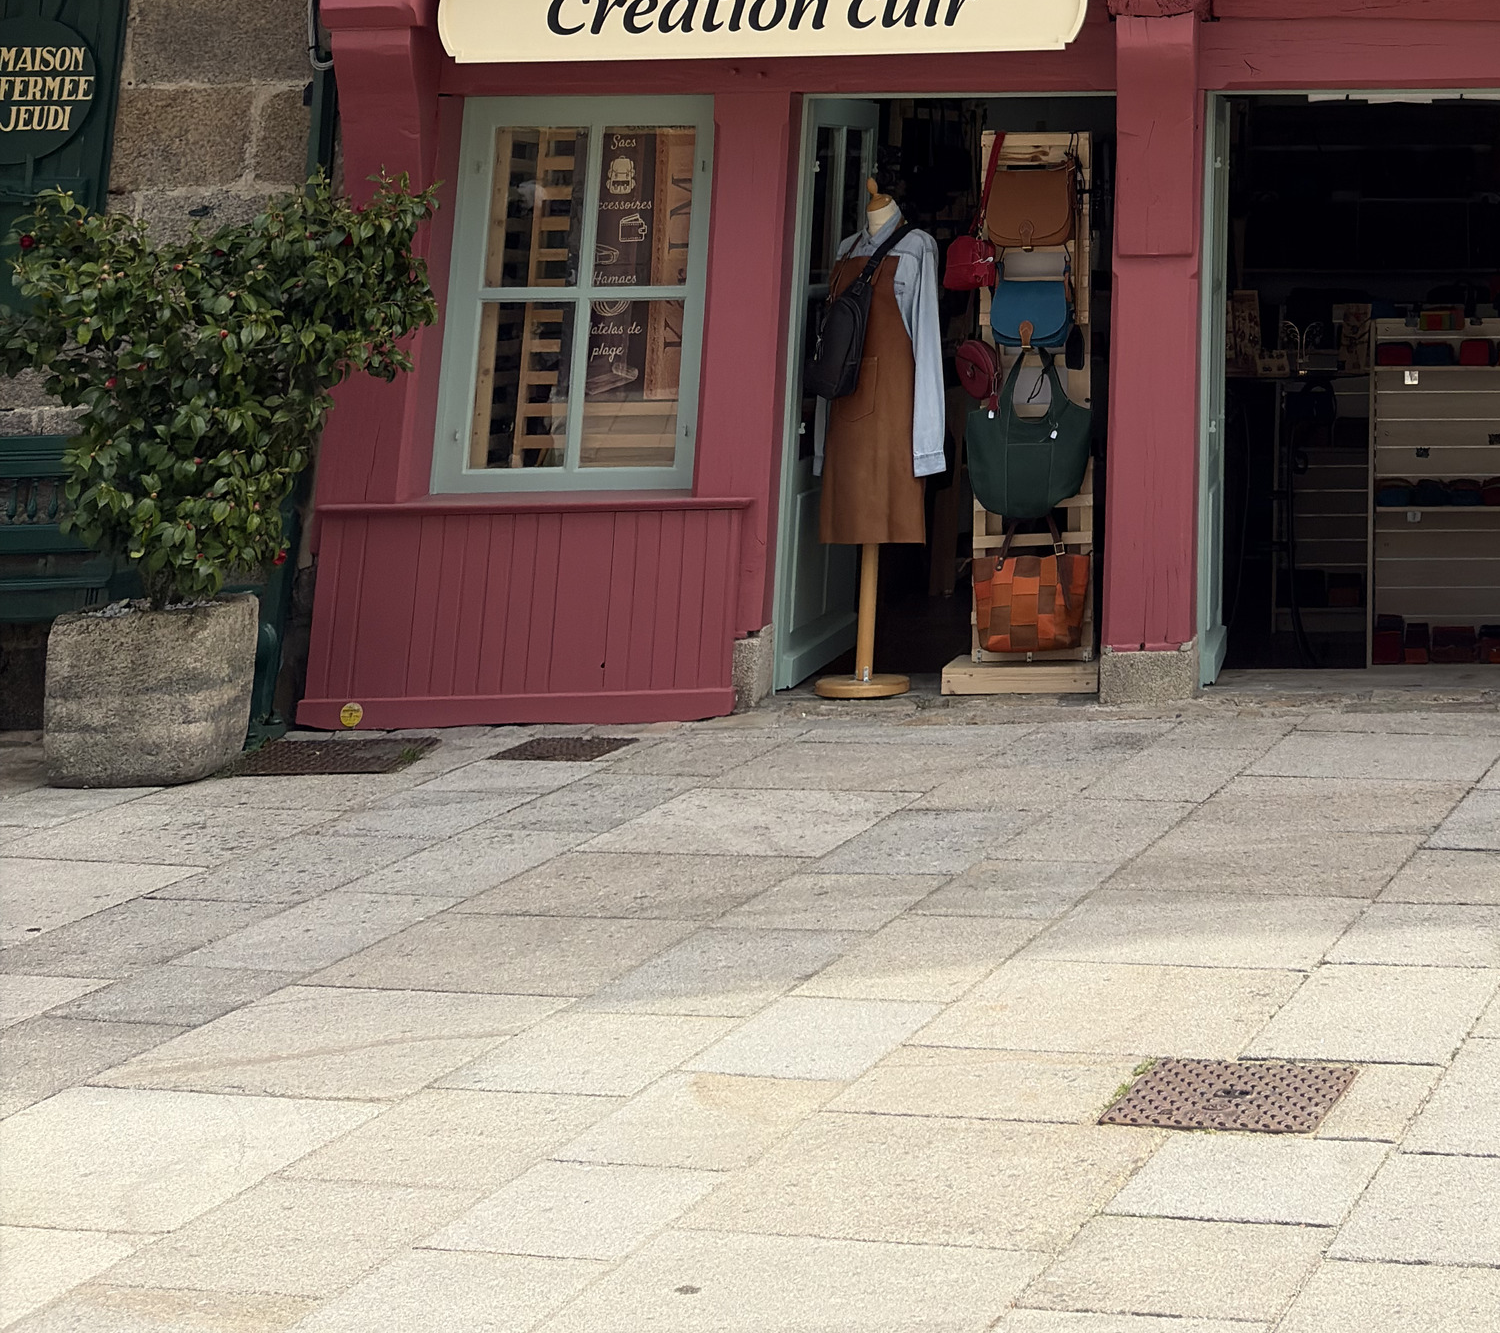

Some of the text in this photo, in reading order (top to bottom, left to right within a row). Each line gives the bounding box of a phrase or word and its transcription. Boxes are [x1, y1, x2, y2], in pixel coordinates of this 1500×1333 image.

[0, 46, 86, 72] MAISON
[0, 75, 95, 101] FERMEE
[0, 105, 73, 132] JEUDI
[610, 134, 637, 150] Sacs
[599, 198, 653, 210] ccessoires
[589, 321, 643, 338] atelas de
[590, 342, 625, 363] plage
